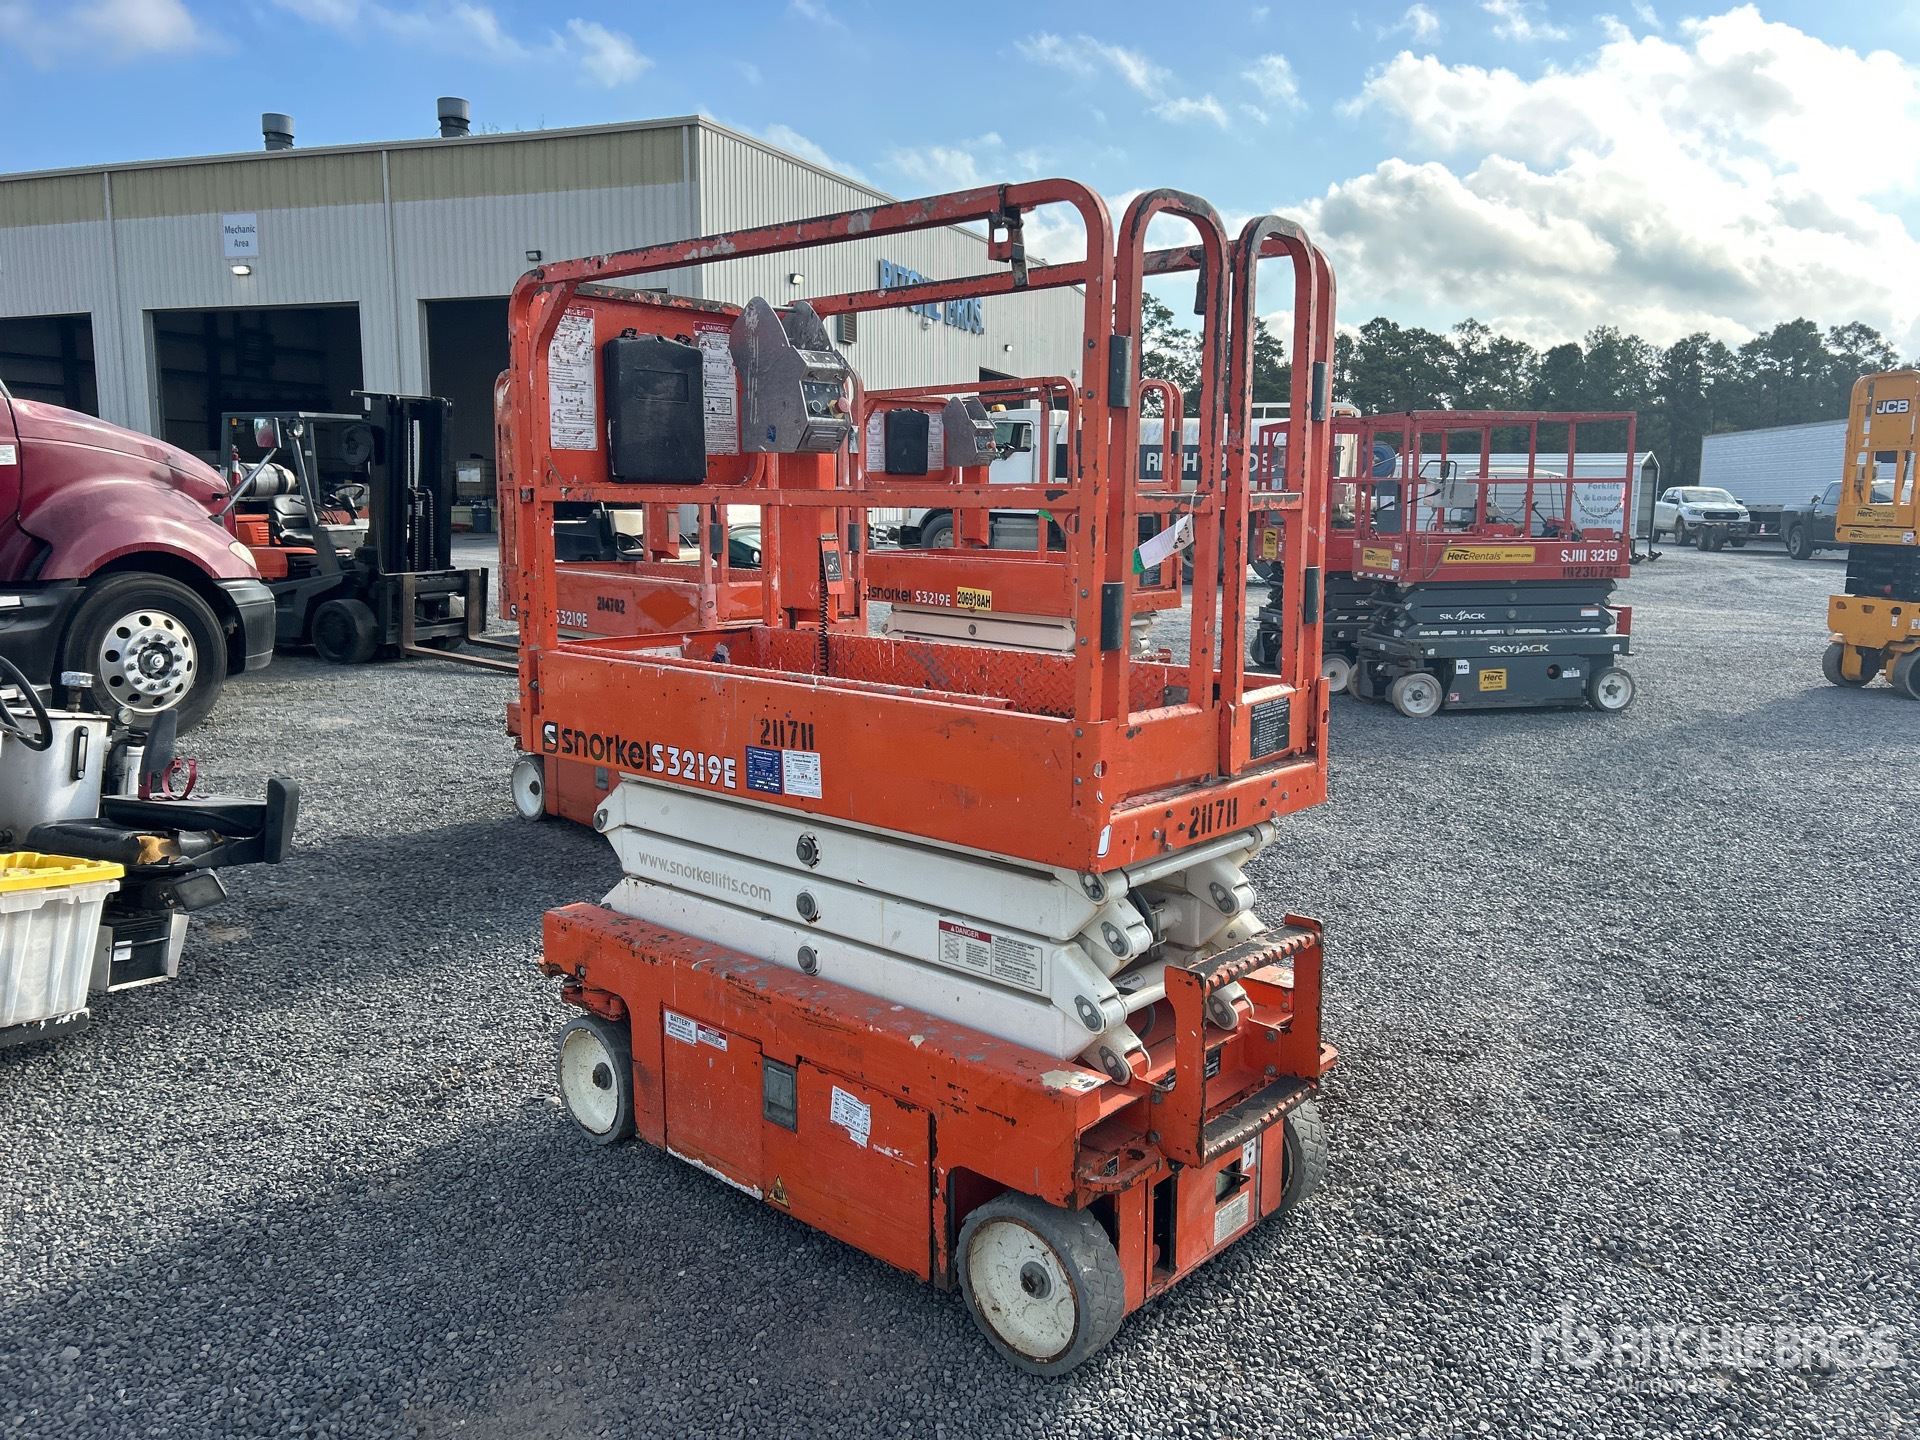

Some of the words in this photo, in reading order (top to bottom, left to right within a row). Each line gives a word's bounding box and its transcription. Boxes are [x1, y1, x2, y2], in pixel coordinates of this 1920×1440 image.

[224, 225, 256, 234] Mechanic
[234, 239, 249, 247] Area
[1876, 400, 1909, 414] JCB
[1580, 517, 1600, 526] Stop
[1590, 549, 1618, 562] 3219
[915, 590, 951, 607] S3219E
[1483, 673, 1503, 682] Herc
[760, 718, 814, 750] 211711
[651, 743, 737, 789] S3219E
[1189, 797, 1238, 839] 211711
[638, 851, 772, 902] www.snorkellifts.com
[955, 927, 980, 939] DANGER
